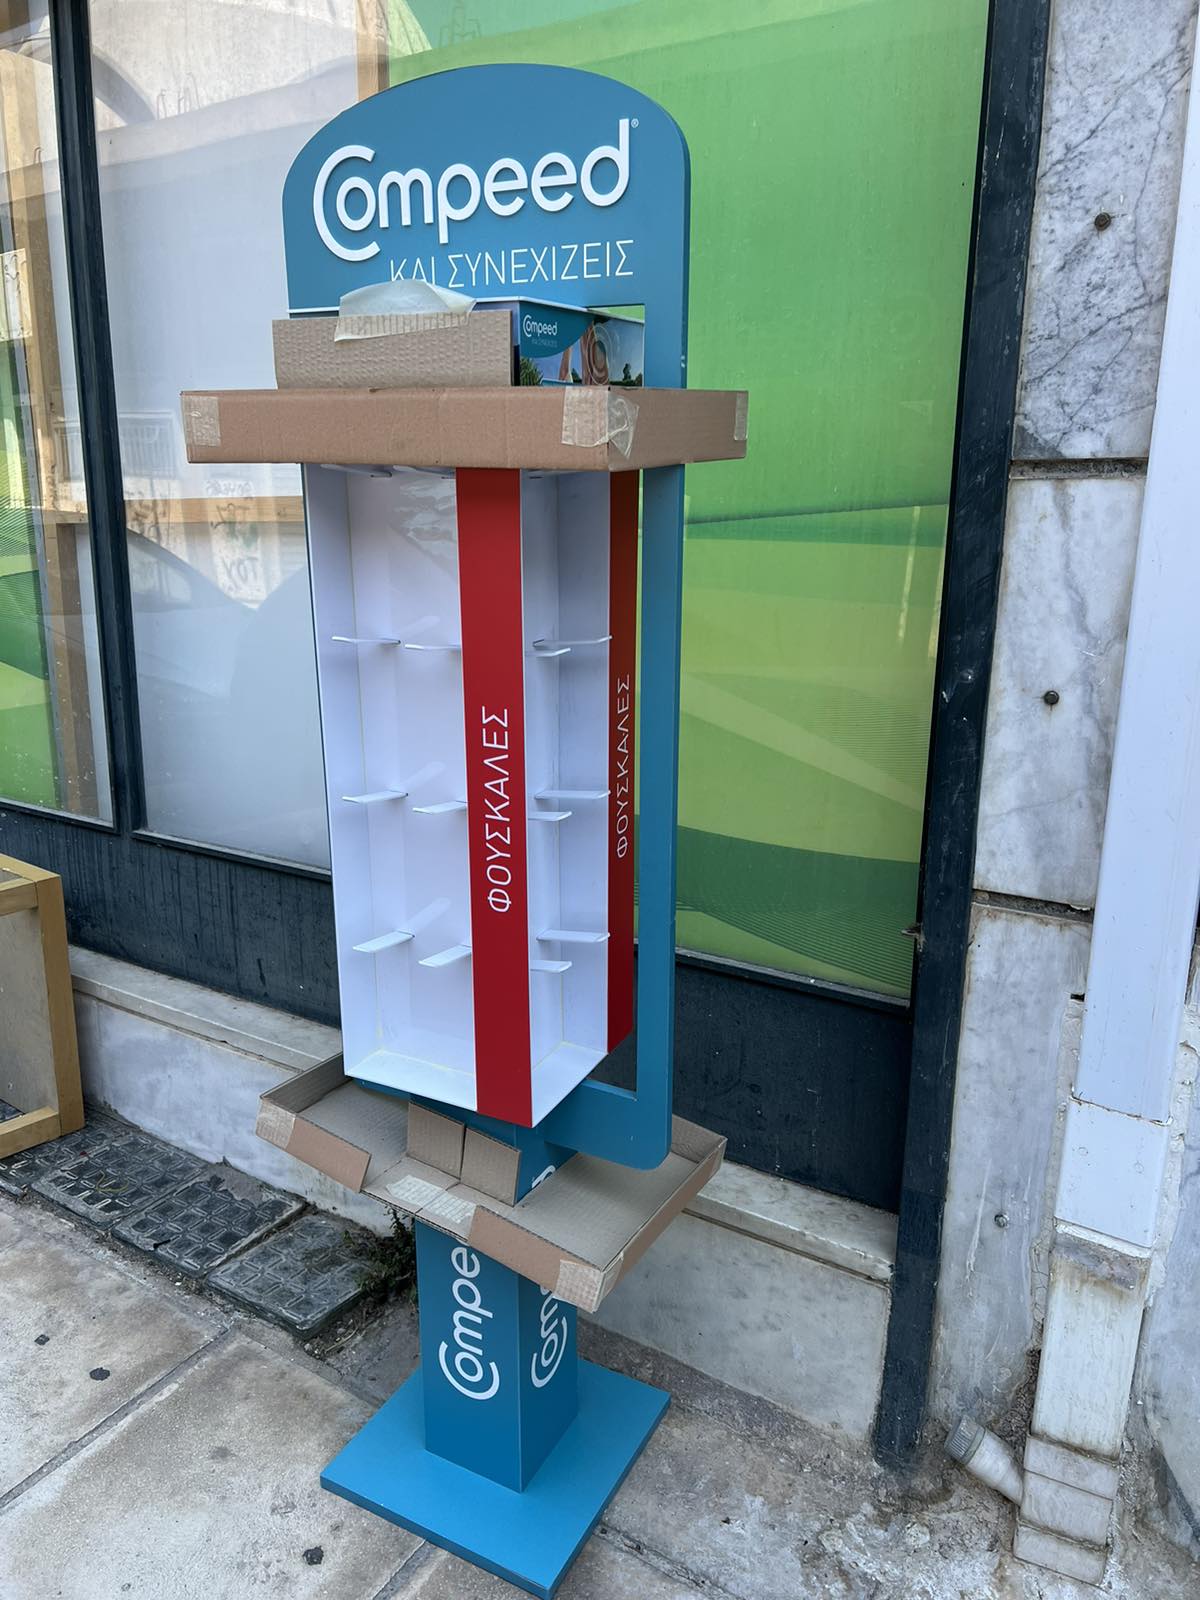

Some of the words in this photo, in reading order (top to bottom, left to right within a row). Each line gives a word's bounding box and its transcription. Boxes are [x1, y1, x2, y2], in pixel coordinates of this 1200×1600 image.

[448, 239, 634, 289] ΣΥΝΕΧΙΖΕΙΣ
[522, 314, 558, 338] Compeed
[481, 705, 512, 913] ΦΟΥΣΚΑΛΕΣ
[616, 674, 630, 859] ΦΟΥΣΚΑΛΕΣ
[438, 1239, 500, 1400] Compe
